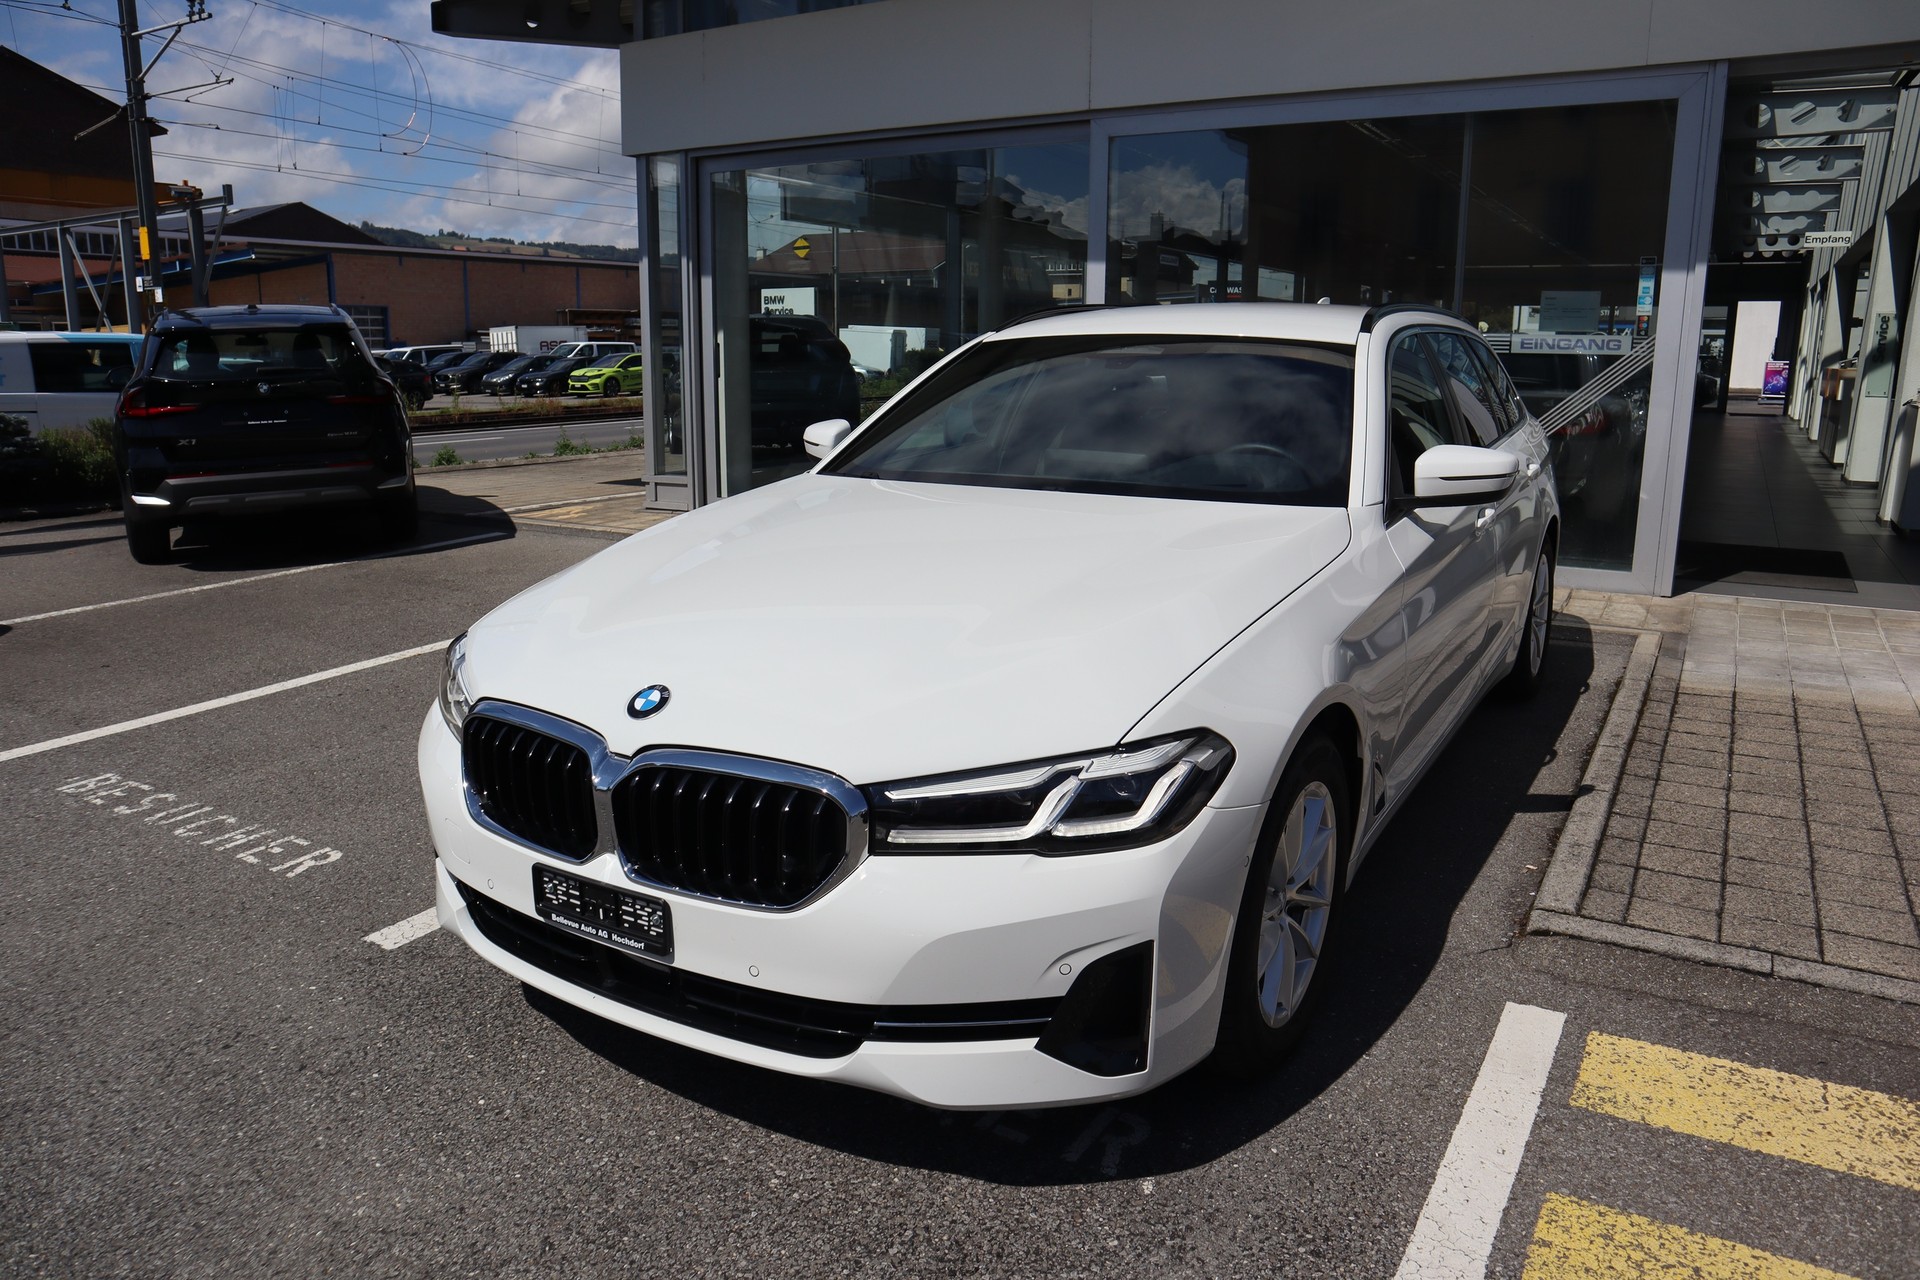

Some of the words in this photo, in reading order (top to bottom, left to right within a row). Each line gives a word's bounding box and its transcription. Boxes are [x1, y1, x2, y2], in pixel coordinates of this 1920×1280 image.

[1804, 235, 1851, 244] Empfang
[763, 295, 785, 305] BMW
[1520, 337, 1622, 351] EINGANG
[1873, 315, 1890, 363] Service
[540, 340, 568, 351] AS
[176, 438, 196, 446] X1
[56, 773, 343, 878] BESUCHER
[551, 913, 580, 929] Bellevue
[580, 923, 597, 935] Auto
[597, 929, 609, 939] AG
[611, 933, 645, 950] Hochdorf
